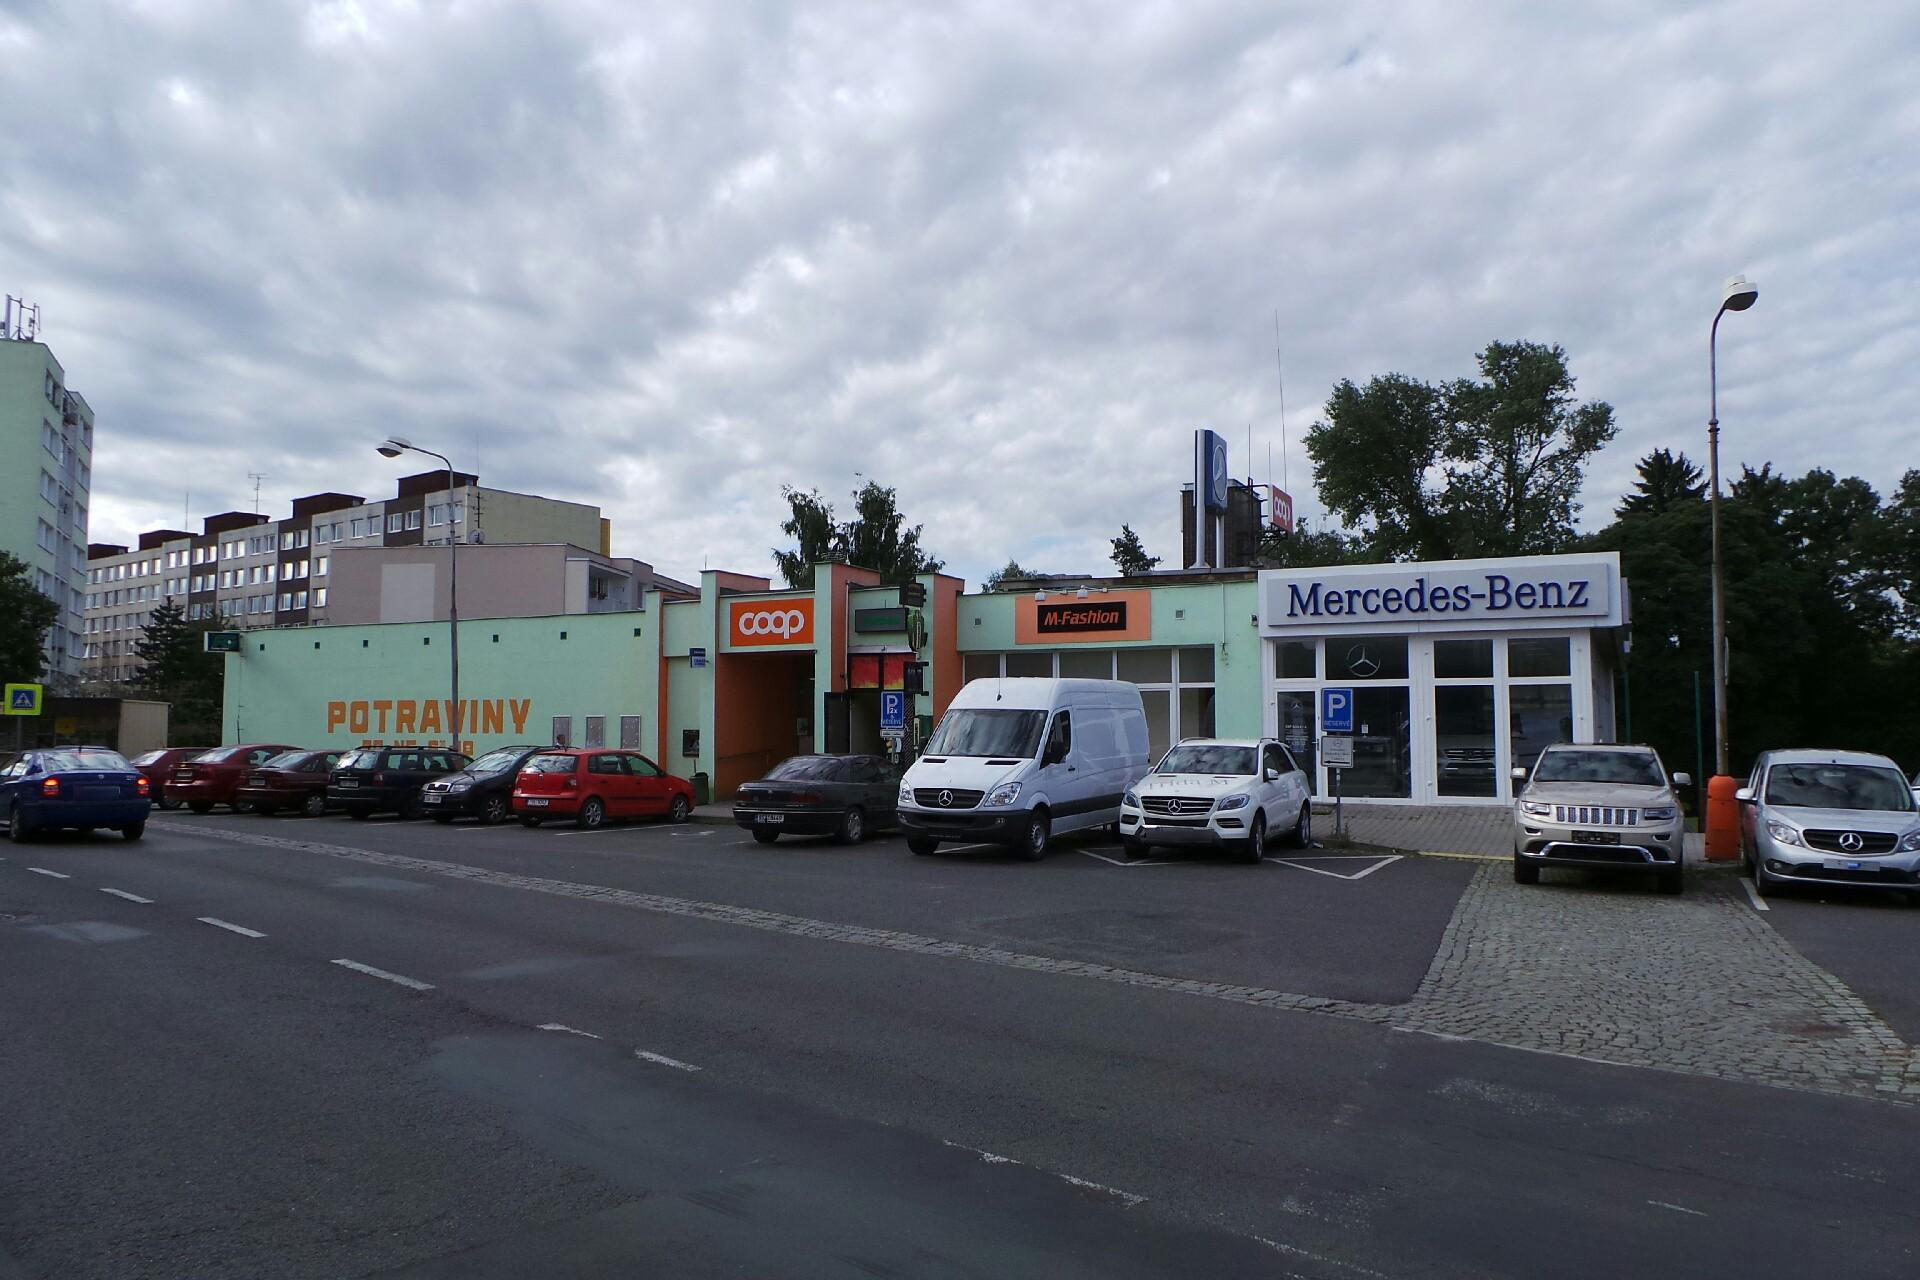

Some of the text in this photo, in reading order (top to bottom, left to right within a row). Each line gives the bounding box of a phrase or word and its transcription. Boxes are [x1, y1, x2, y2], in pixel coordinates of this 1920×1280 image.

[1286, 575, 1589, 617] Mercedes-Benz
[738, 609, 805, 639] coop
[1044, 610, 1119, 626] M-Fashion
[327, 698, 531, 734] POTRAVINY
[886, 694, 899, 714] P
[1328, 693, 1346, 718] P
